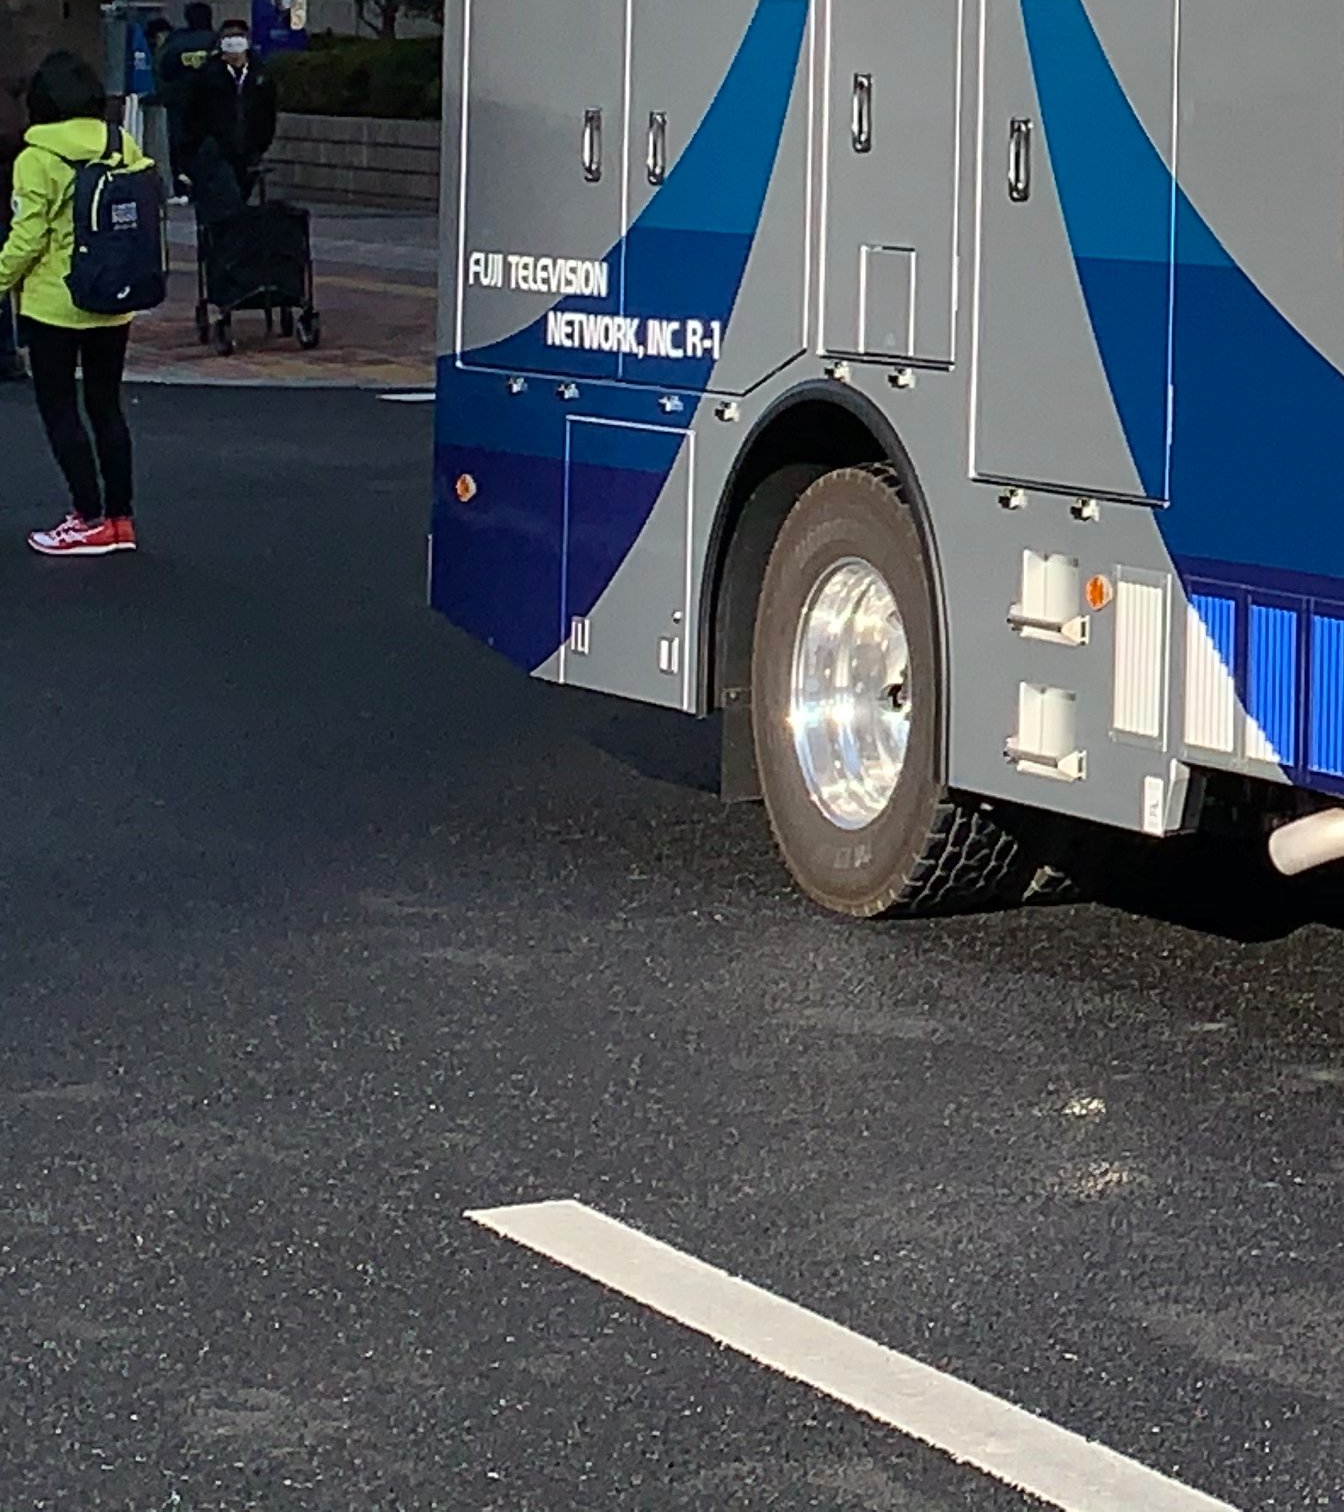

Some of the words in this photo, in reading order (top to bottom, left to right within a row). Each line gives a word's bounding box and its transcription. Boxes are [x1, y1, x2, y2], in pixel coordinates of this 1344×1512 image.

[468, 251, 502, 289] FUJI
[507, 254, 608, 298] TELEVISION
[546, 310, 645, 359] NETWORK,
[686, 320, 721, 360] R-1
